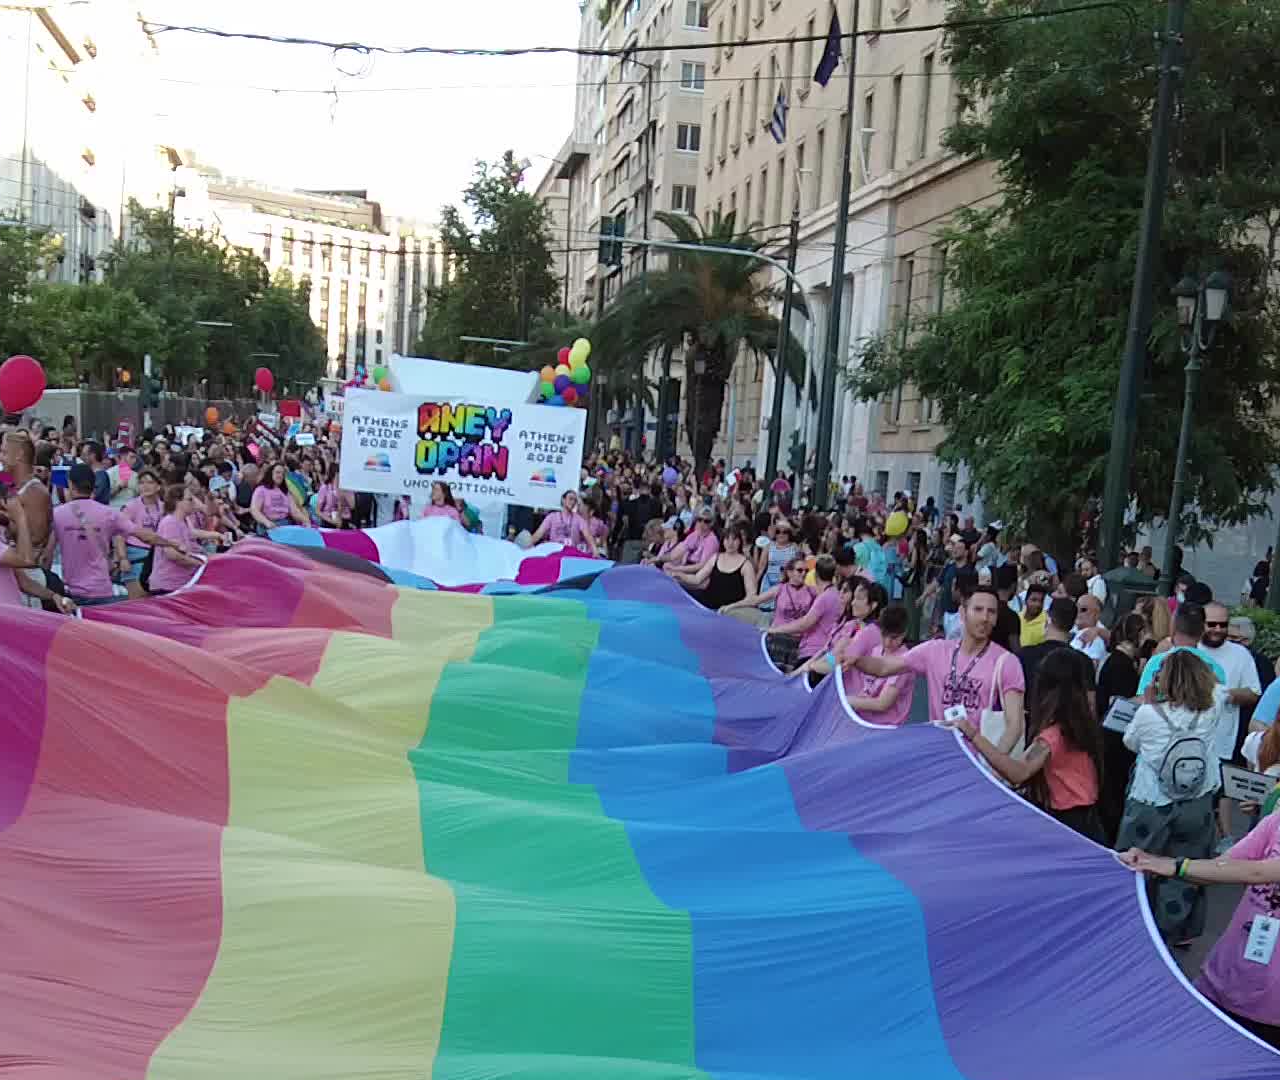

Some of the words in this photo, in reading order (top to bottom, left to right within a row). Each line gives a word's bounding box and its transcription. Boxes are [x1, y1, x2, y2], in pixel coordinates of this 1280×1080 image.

[352, 415, 409, 430] ATHENS
[357, 427, 403, 440] PRIDE
[519, 430, 575, 444] ATHENS
[359, 438, 399, 449] 2022
[524, 441, 568, 454] PRIDE
[526, 453, 564, 465] 2022
[403, 479, 515, 497] UNCDITIONAL
